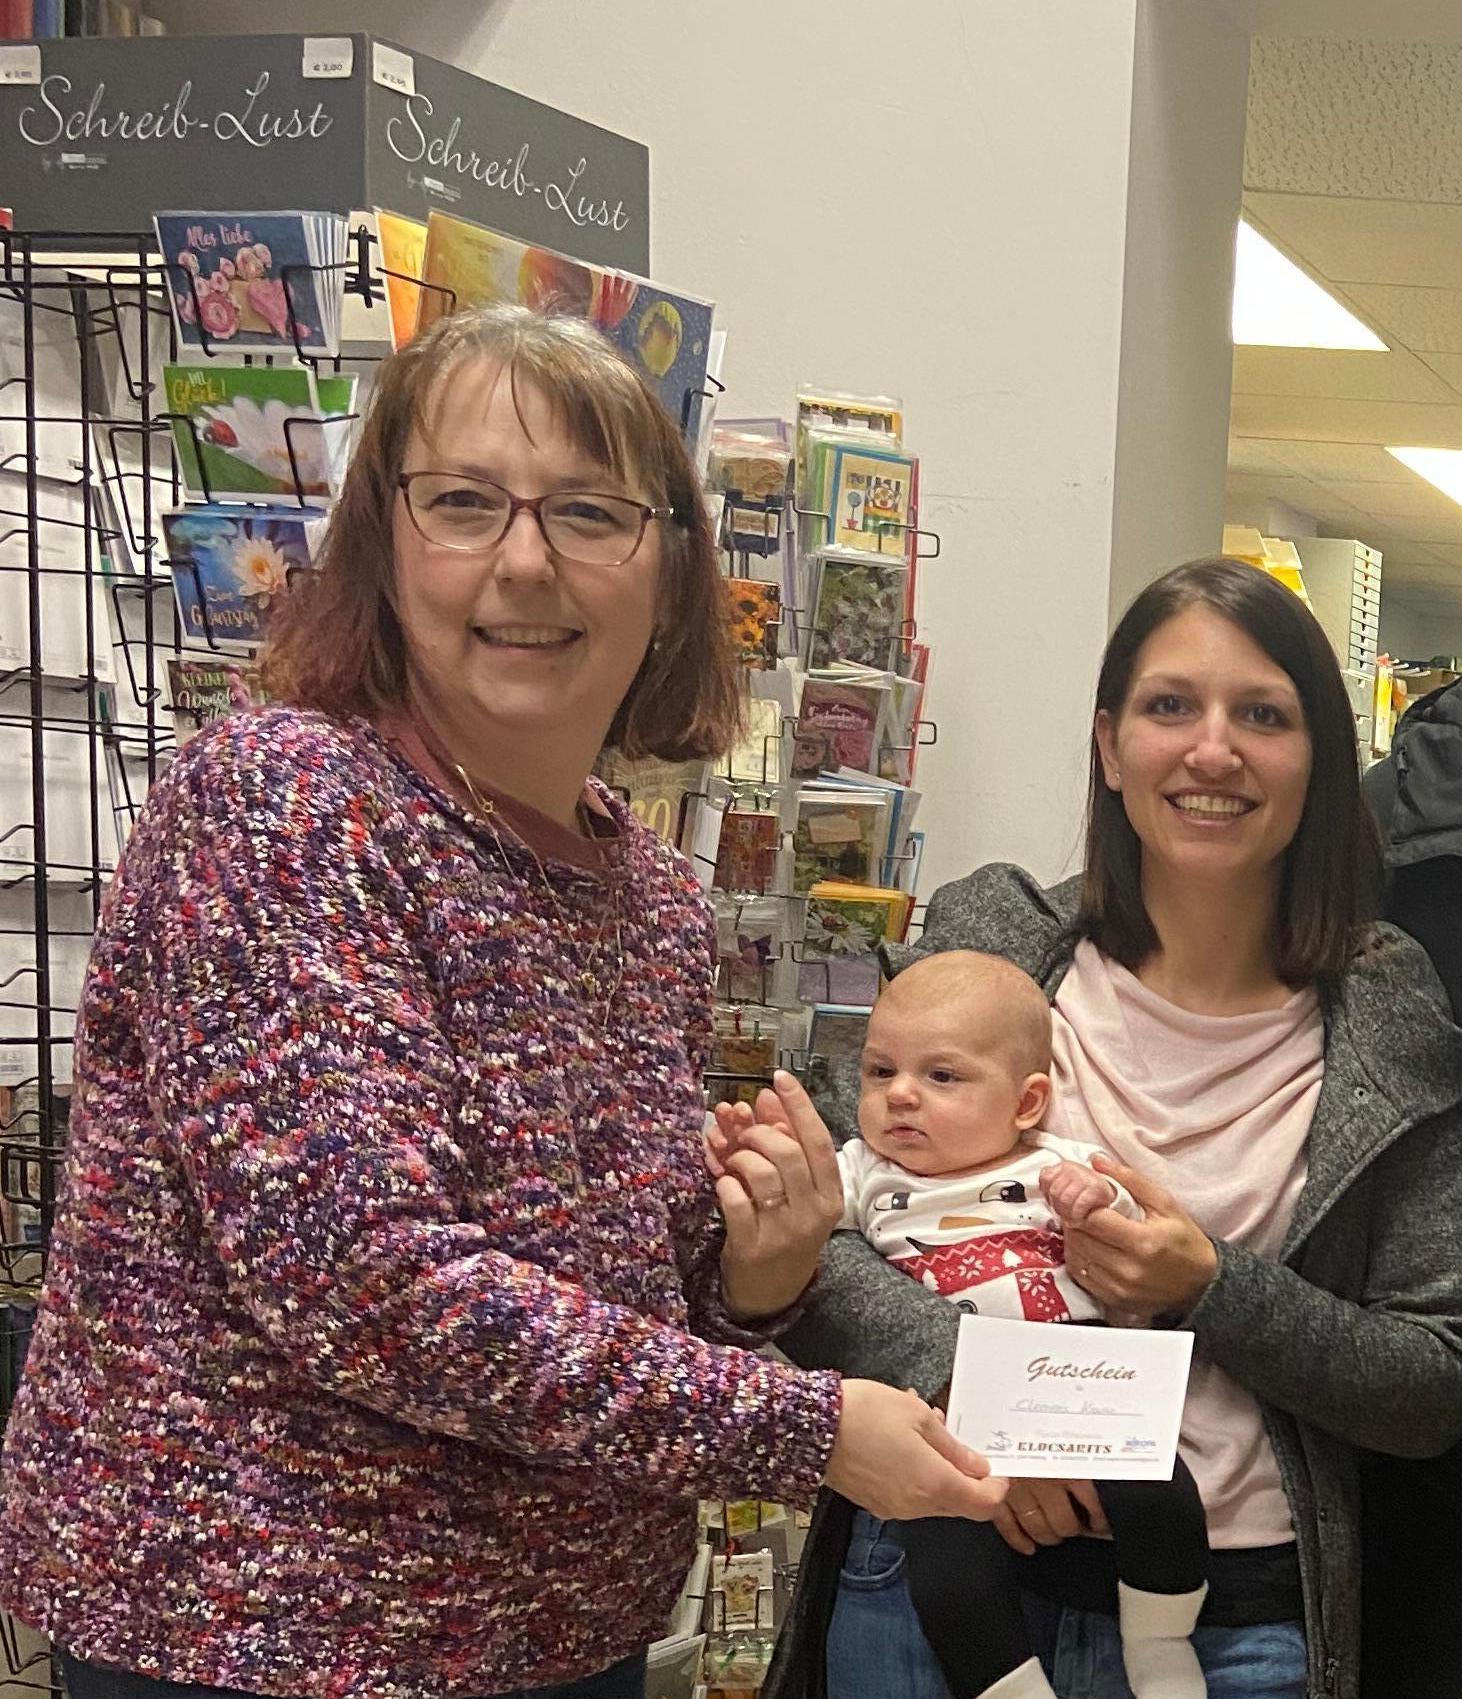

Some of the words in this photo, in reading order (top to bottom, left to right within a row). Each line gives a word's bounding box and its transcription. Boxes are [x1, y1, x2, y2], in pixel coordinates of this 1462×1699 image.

[19, 71, 334, 147] Schreib-Lust
[387, 93, 632, 231] Schreib-Lust
[1027, 1356, 1137, 1382] Gutschein
